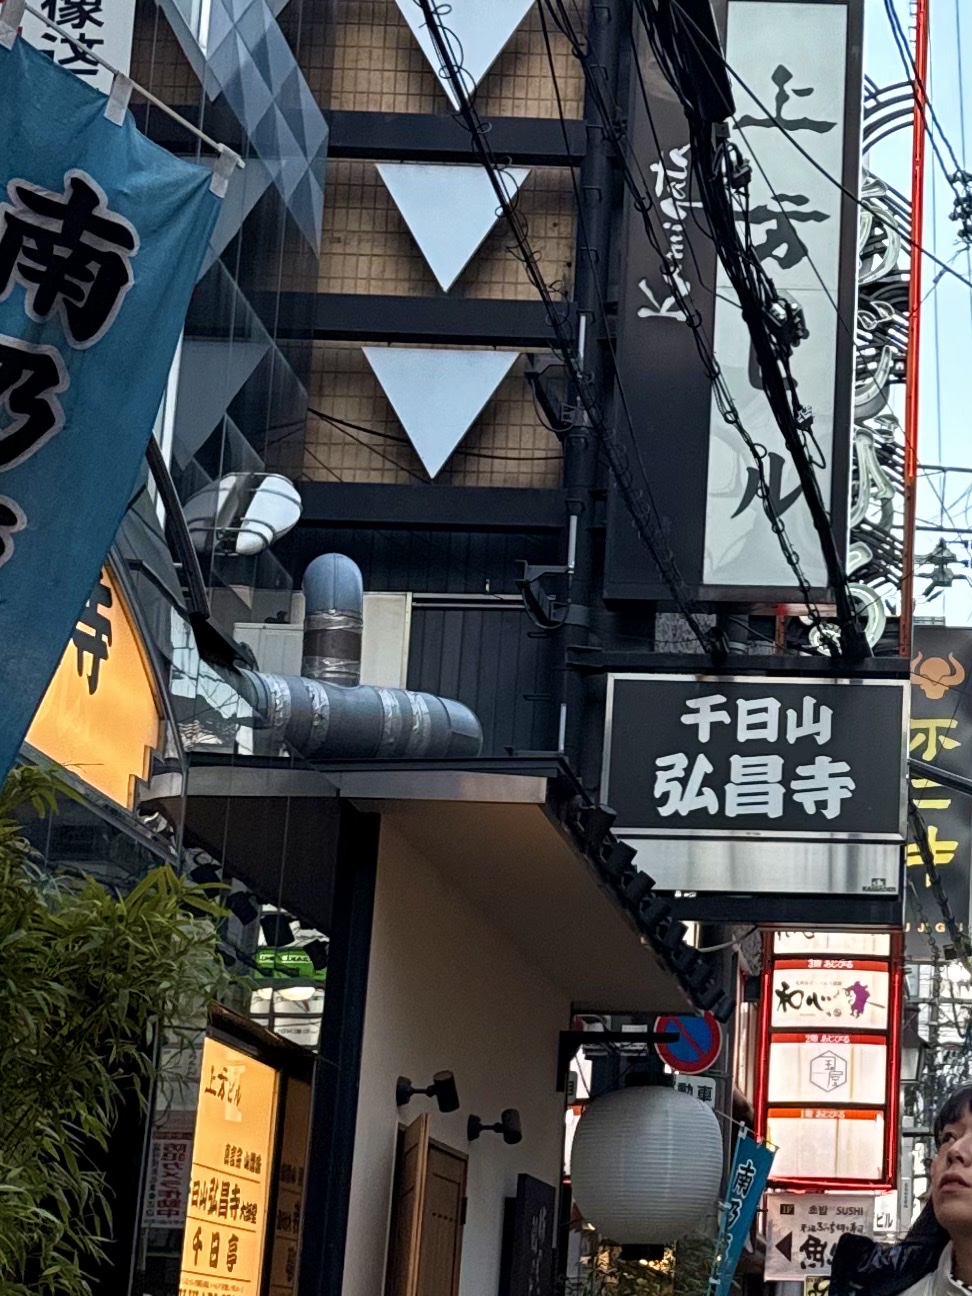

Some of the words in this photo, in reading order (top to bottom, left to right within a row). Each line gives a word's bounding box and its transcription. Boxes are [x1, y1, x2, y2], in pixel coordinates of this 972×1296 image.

[680, 694, 833, 745] 千日山
[653, 752, 856, 820] 弘昌寺
[836, 1207, 864, 1216] SUSHI
[800, 1234, 837, 1270] 魚
